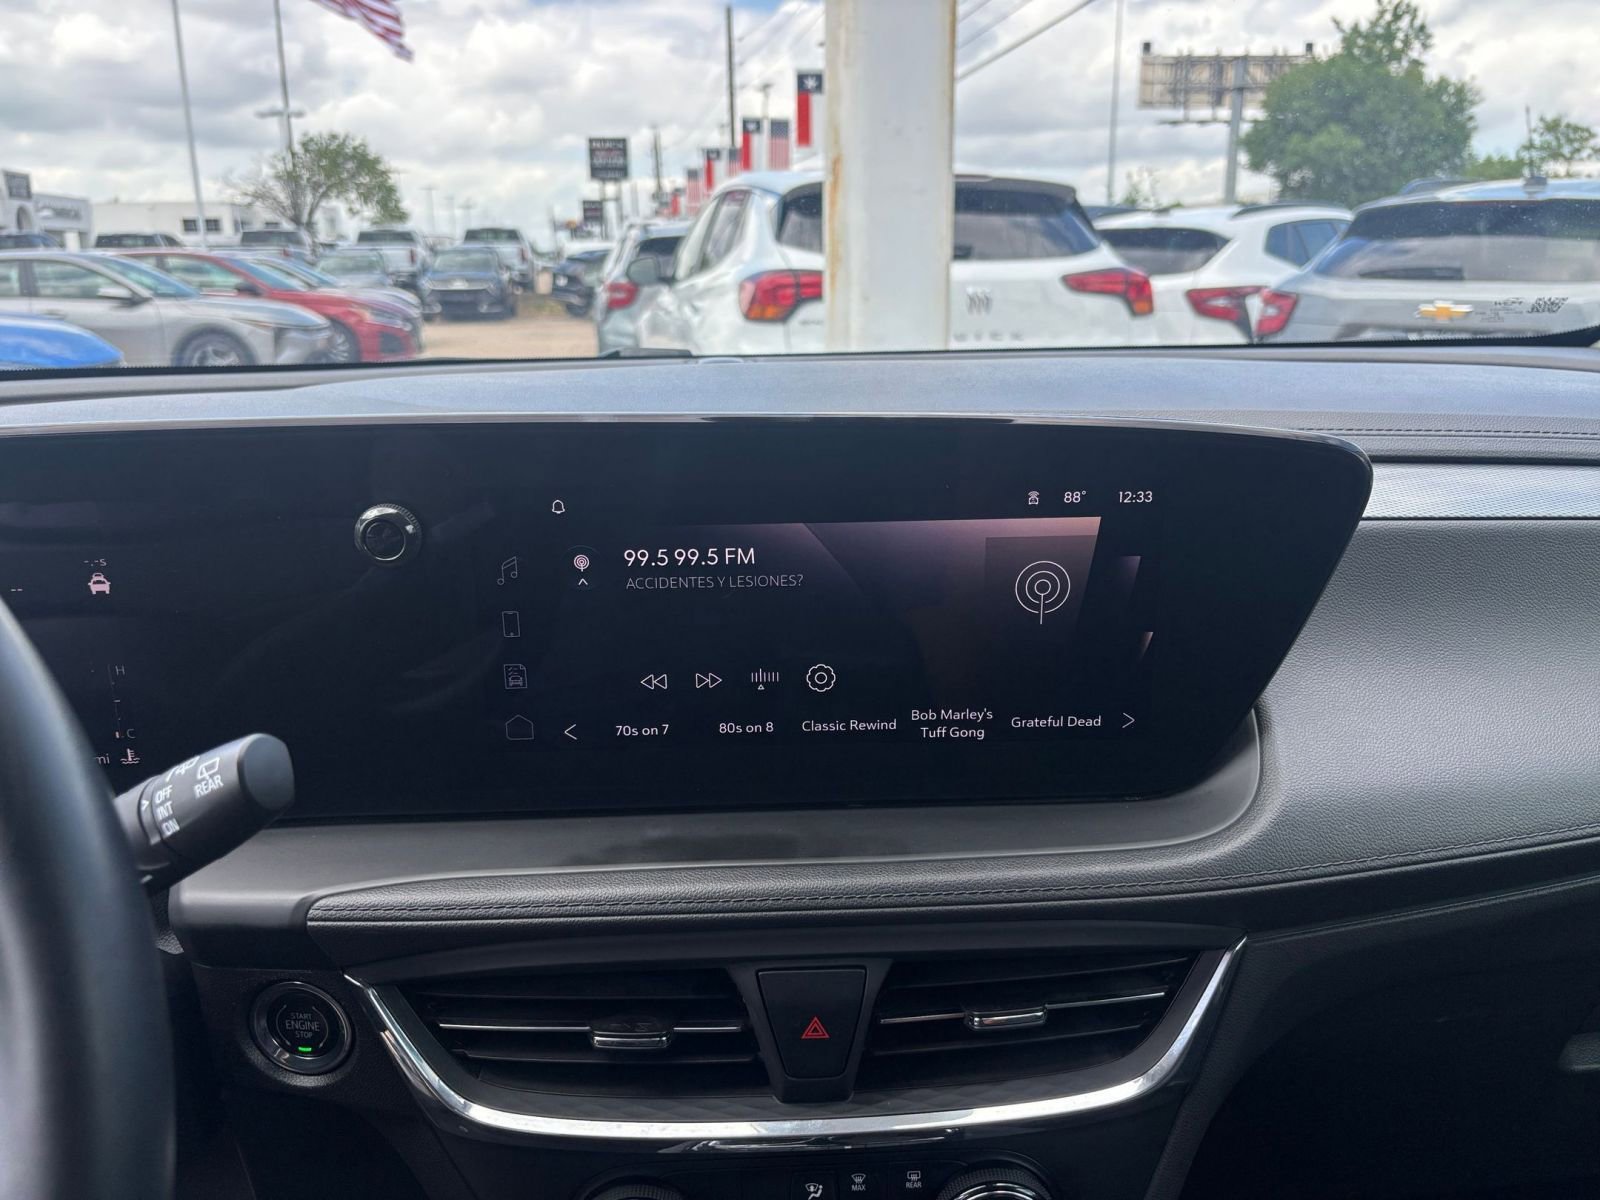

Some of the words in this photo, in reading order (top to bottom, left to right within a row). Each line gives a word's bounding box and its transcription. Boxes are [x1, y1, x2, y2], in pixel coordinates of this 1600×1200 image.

[1063, 490, 1087, 503] 88°
[1119, 490, 1153, 503] 12:33
[623, 549, 669, 567] 99.5
[674, 548, 719, 566] 99.5
[725, 547, 755, 565] FM
[626, 576, 715, 590] ACCIDENTES
[717, 576, 727, 588] Y
[729, 574, 804, 588] LESIONES?
[911, 708, 937, 721] Bob
[940, 708, 993, 722] Marley's
[719, 722, 743, 734] 80s
[745, 723, 762, 733] on
[765, 721, 774, 733] 8
[801, 720, 847, 732] Classic
[850, 719, 897, 731] Rewind
[1011, 716, 1063, 729] Grateful
[1067, 716, 1101, 728] Dead
[615, 725, 639, 737] 70s
[641, 726, 659, 736] on
[661, 724, 669, 736] 7
[920, 727, 947, 739] Tuff
[949, 727, 985, 740] Gong
[193, 774, 224, 799] REAR
[154, 784, 173, 804] OFF
[156, 801, 173, 820] INT
[162, 818, 180, 836] ON
[290, 1012, 312, 1020] START
[285, 1019, 320, 1031] ENGINE
[295, 1031, 313, 1039] STOP
[851, 1184, 866, 1192] MAX
[905, 1181, 922, 1189] REAR
